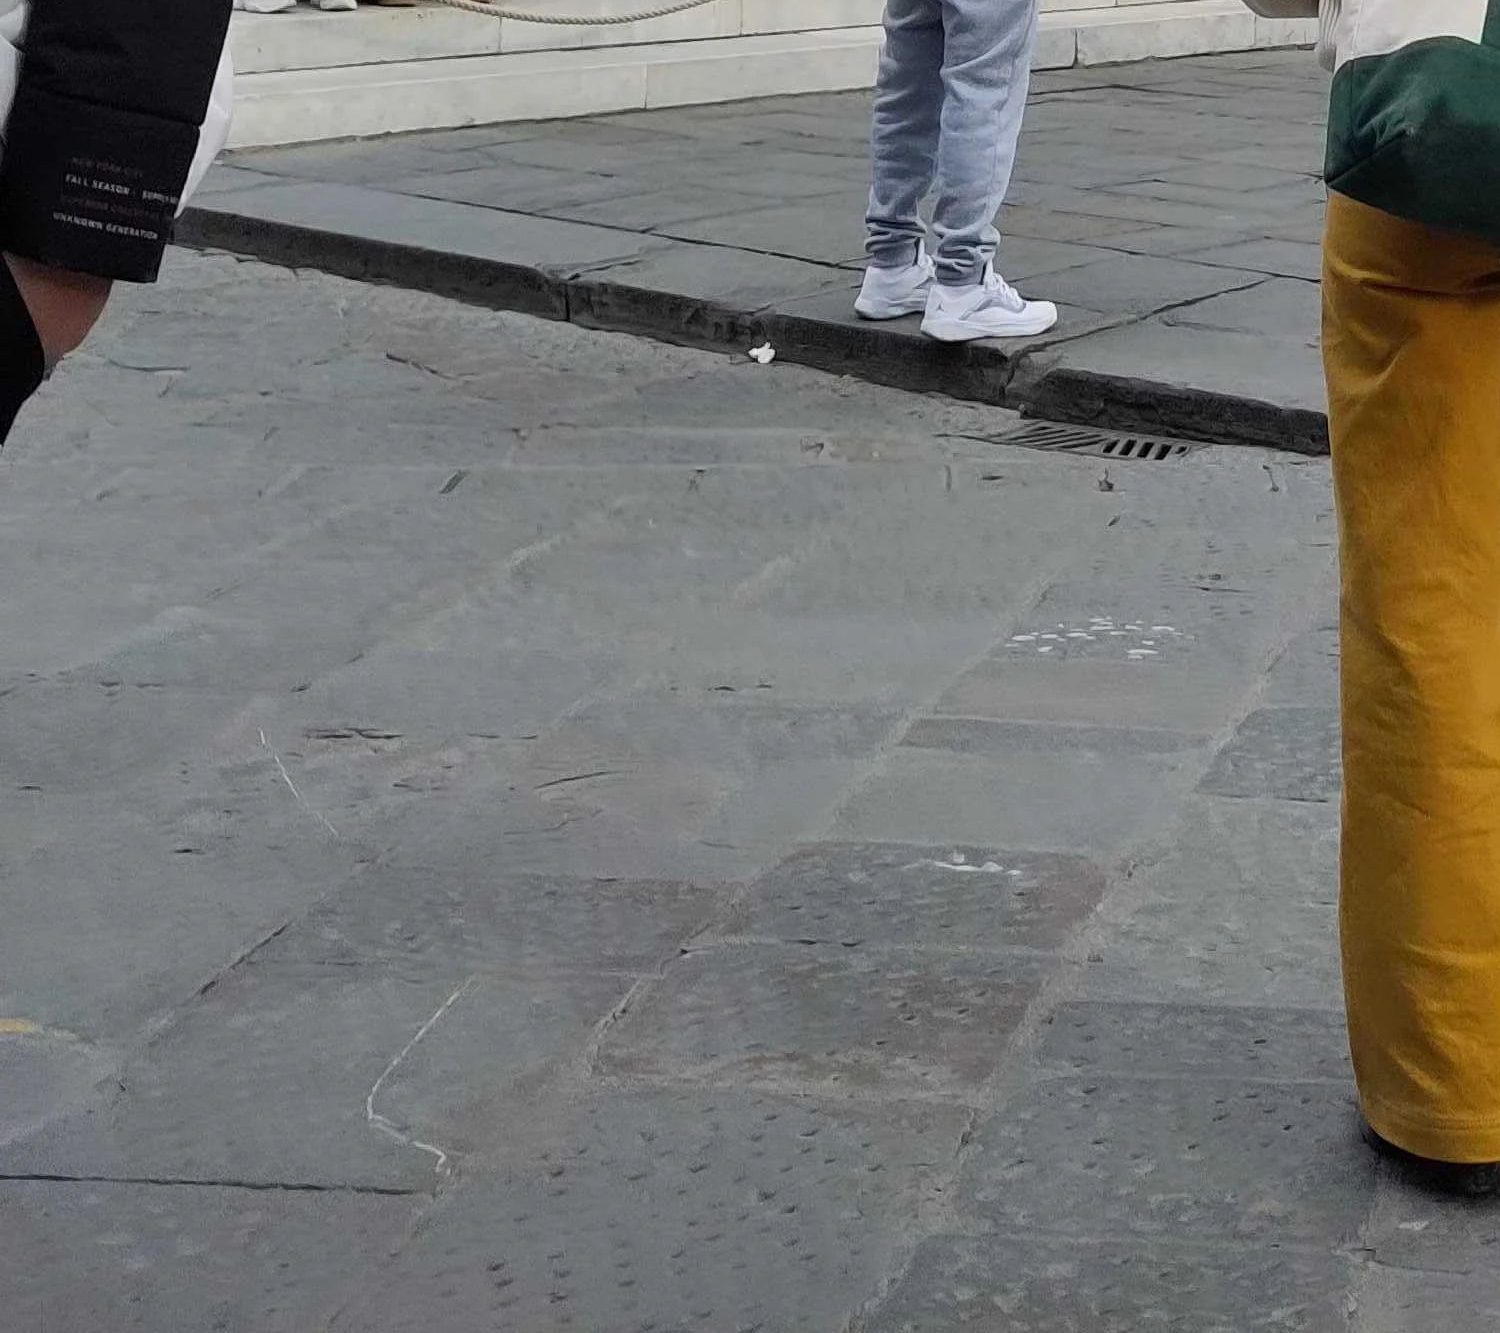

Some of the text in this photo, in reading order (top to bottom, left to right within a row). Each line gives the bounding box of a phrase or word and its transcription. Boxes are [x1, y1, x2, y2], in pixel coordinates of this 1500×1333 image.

[65, 174, 130, 195] FALL SEASON
[53, 212, 159, 240] UNKNOWN GENERATION
